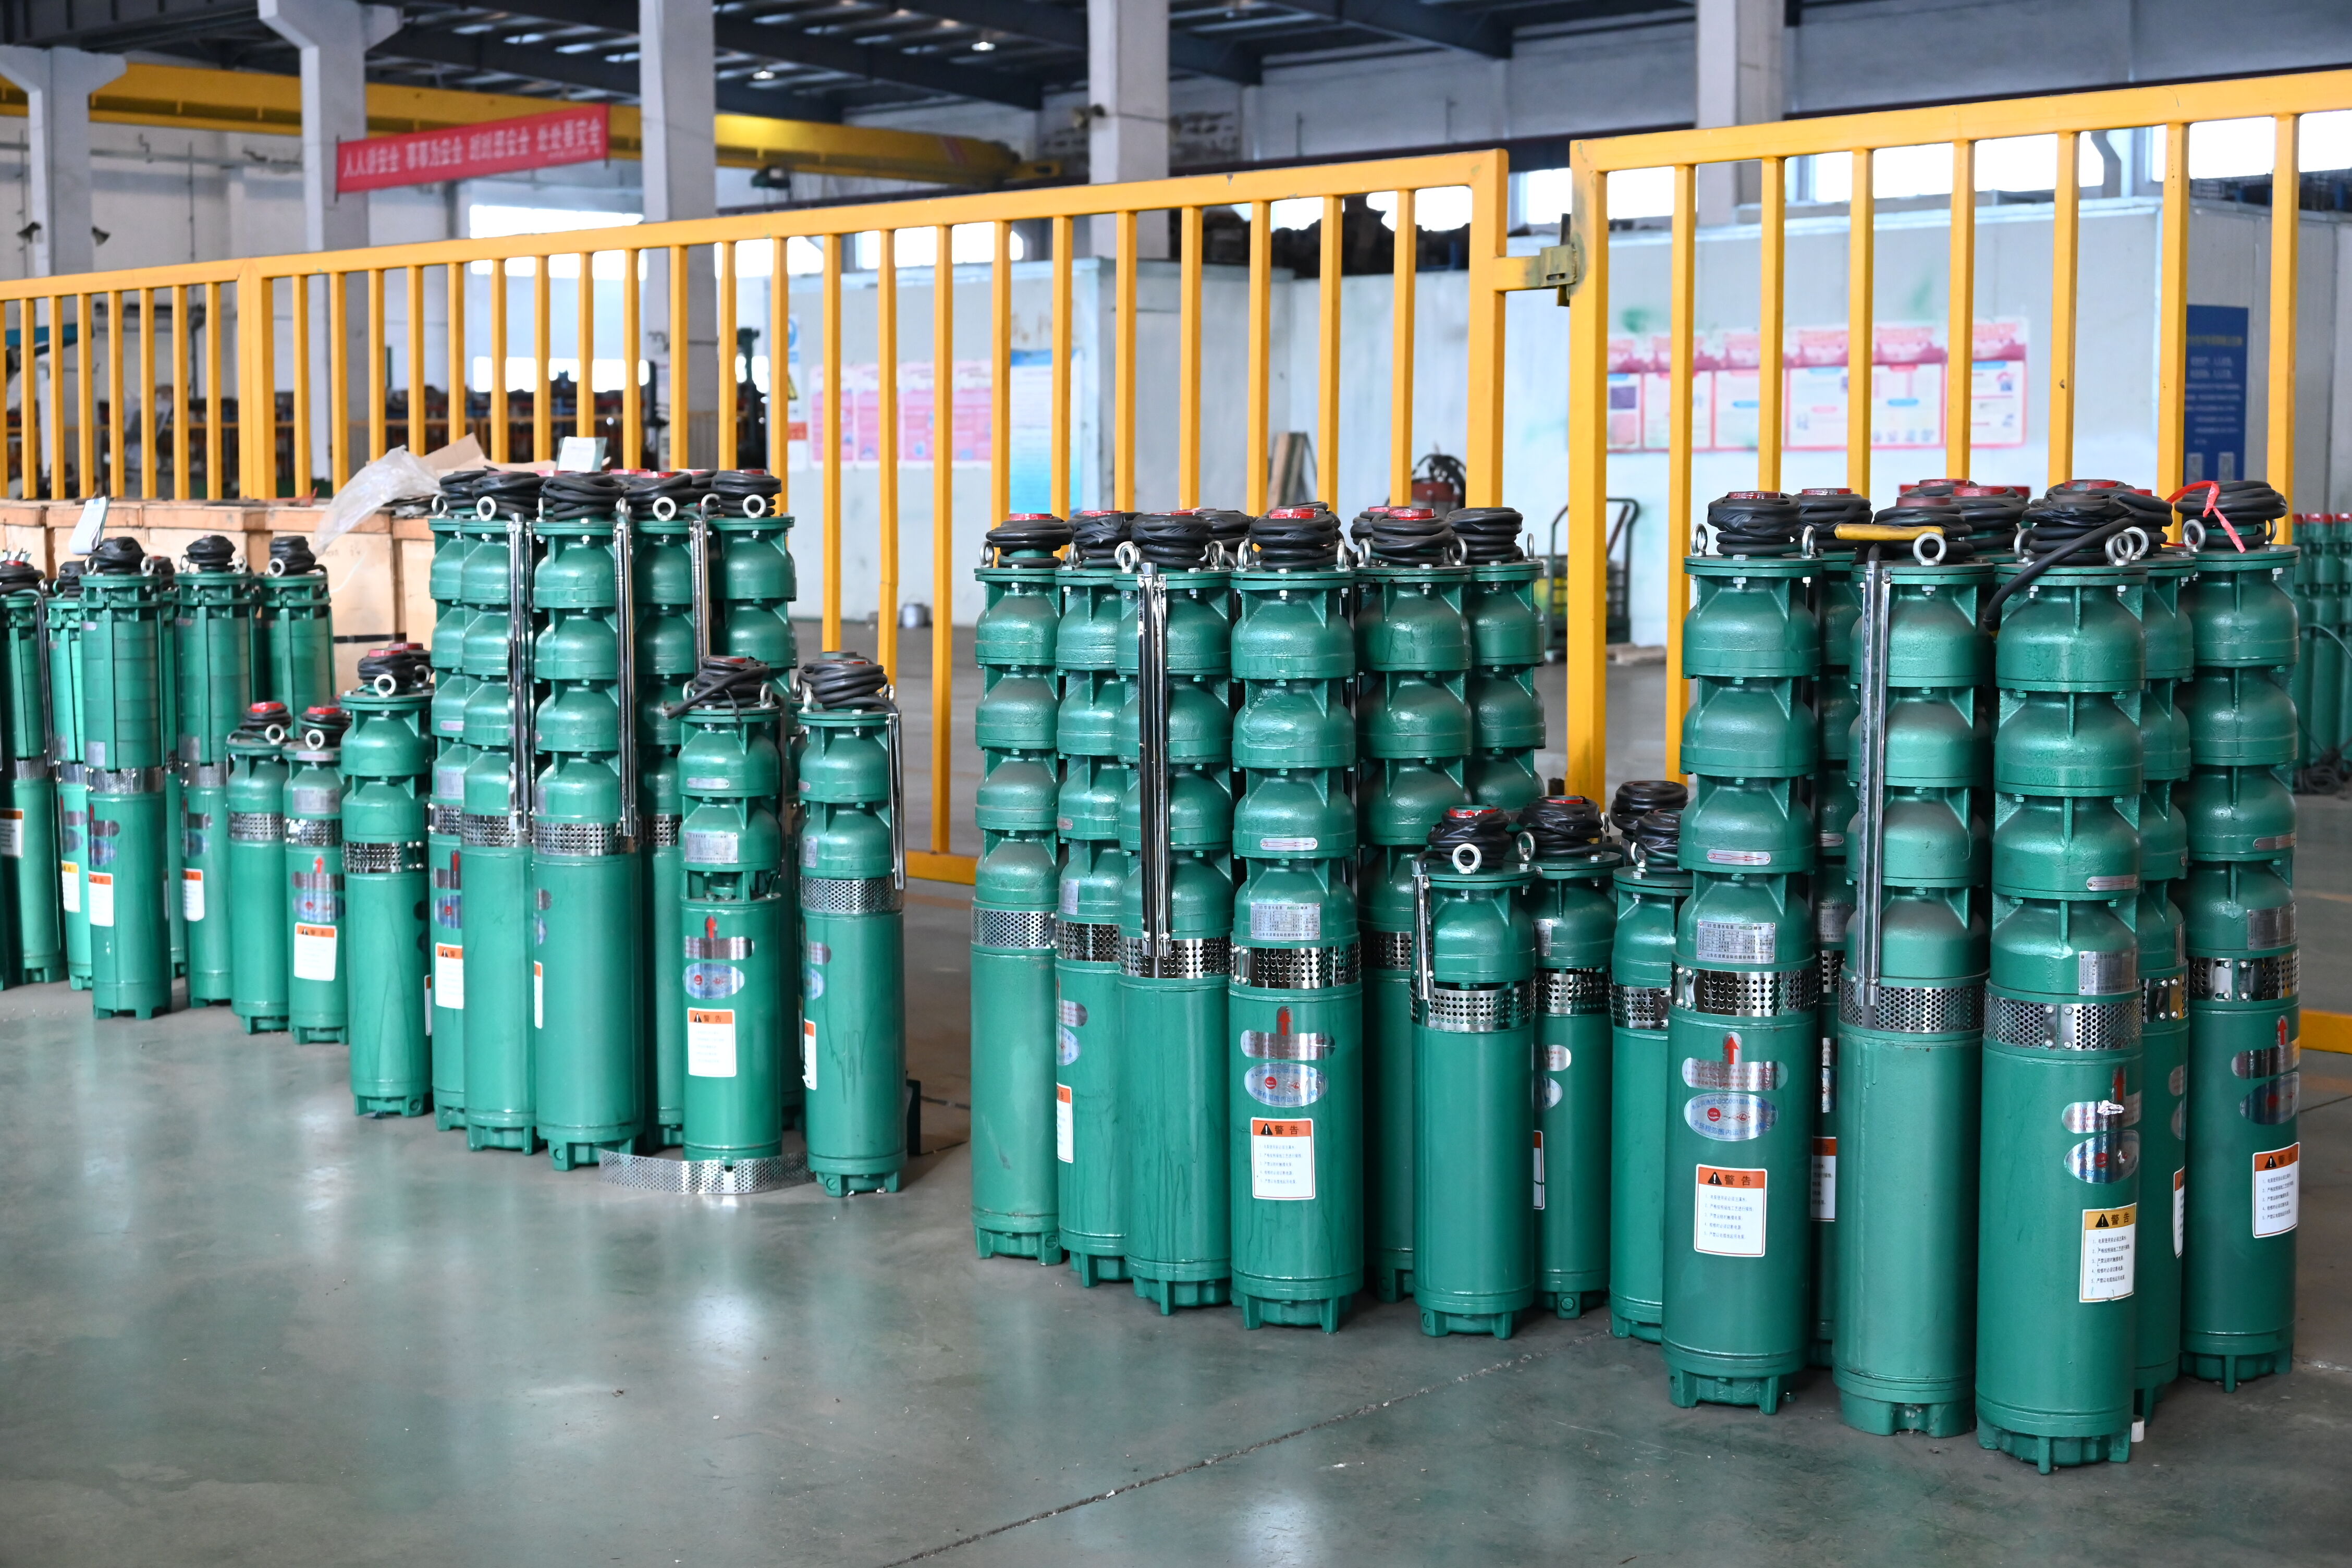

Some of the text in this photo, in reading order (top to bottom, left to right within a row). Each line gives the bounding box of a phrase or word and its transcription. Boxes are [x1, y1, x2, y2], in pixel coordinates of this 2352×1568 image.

[1275, 1125, 1298, 1135] 警告
[1724, 1174, 1751, 1186] 警告
[2111, 1212, 2130, 1225] 警告
